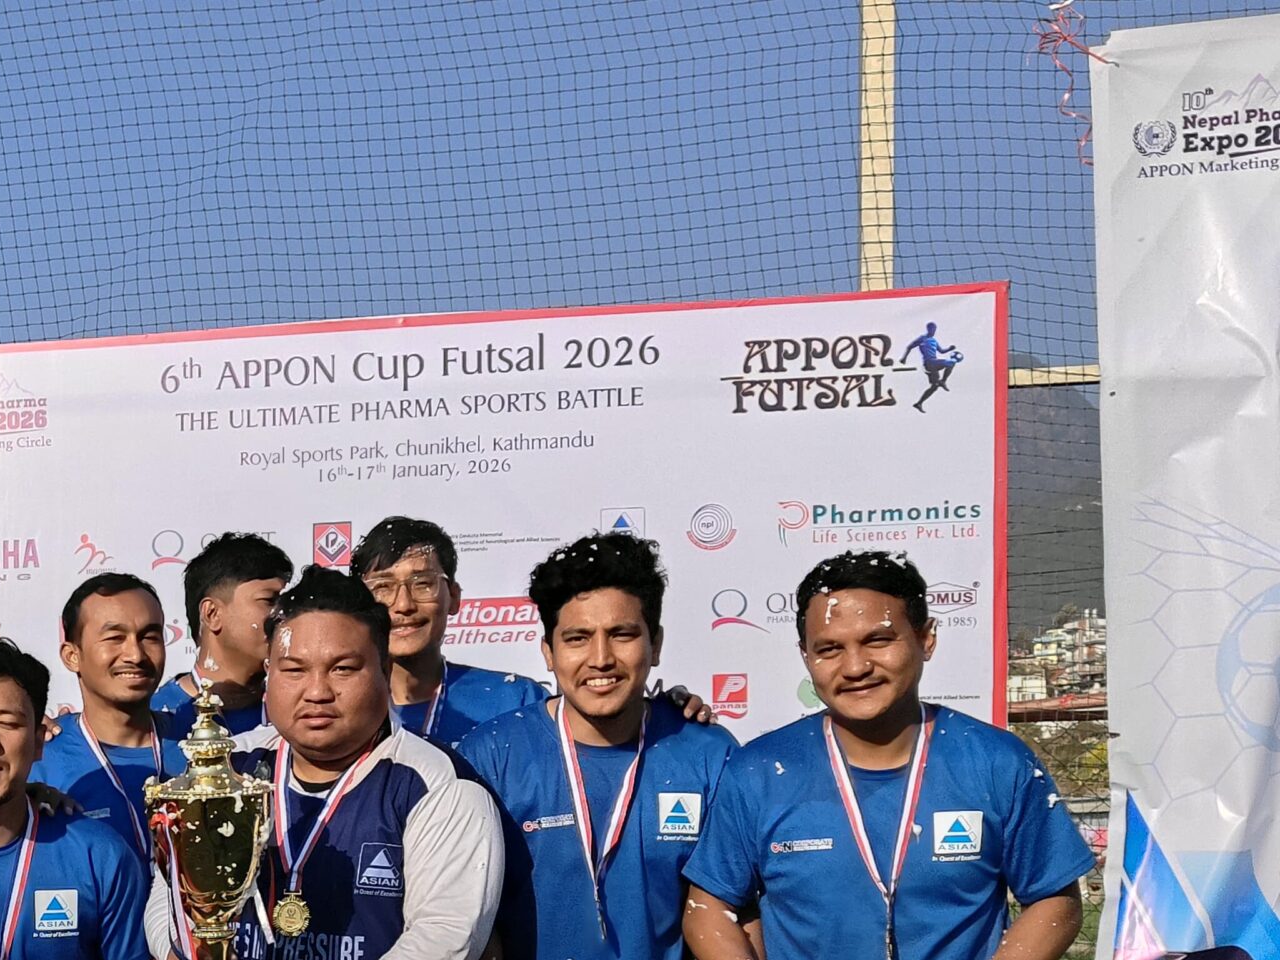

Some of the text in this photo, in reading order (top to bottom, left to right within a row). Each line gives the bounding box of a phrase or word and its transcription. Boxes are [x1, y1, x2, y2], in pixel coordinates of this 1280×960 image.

[1182, 111, 1239, 131] Nepal
[1183, 132, 1249, 155] Expo
[1137, 157, 1280, 178] APPON Marketing
[161, 332, 660, 394] 6th APPON Cup Futsal 2026
[743, 333, 894, 374] APPON
[732, 373, 897, 414] FUTSAL
[176, 386, 645, 432] THE ULTIMATE PHARMA SPORTS BATTLE
[16, 436, 52, 448] Circle
[239, 430, 595, 470] Royal Sports Park, Chunikhel, Kathmandu
[392, 461, 460, 482] January,
[468, 458, 511, 474] 2026
[812, 500, 981, 525] Pharmonics
[812, 524, 980, 543] Life Sciences Pvt. Ltd.
[925, 591, 974, 605] OMUS
[447, 601, 540, 625] ational
[948, 616, 978, 628] 1985)
[443, 629, 537, 645] althcare
[938, 843, 977, 851] ASIAN
[359, 876, 400, 887] ASIAN
[38, 920, 74, 928] ASIAN
